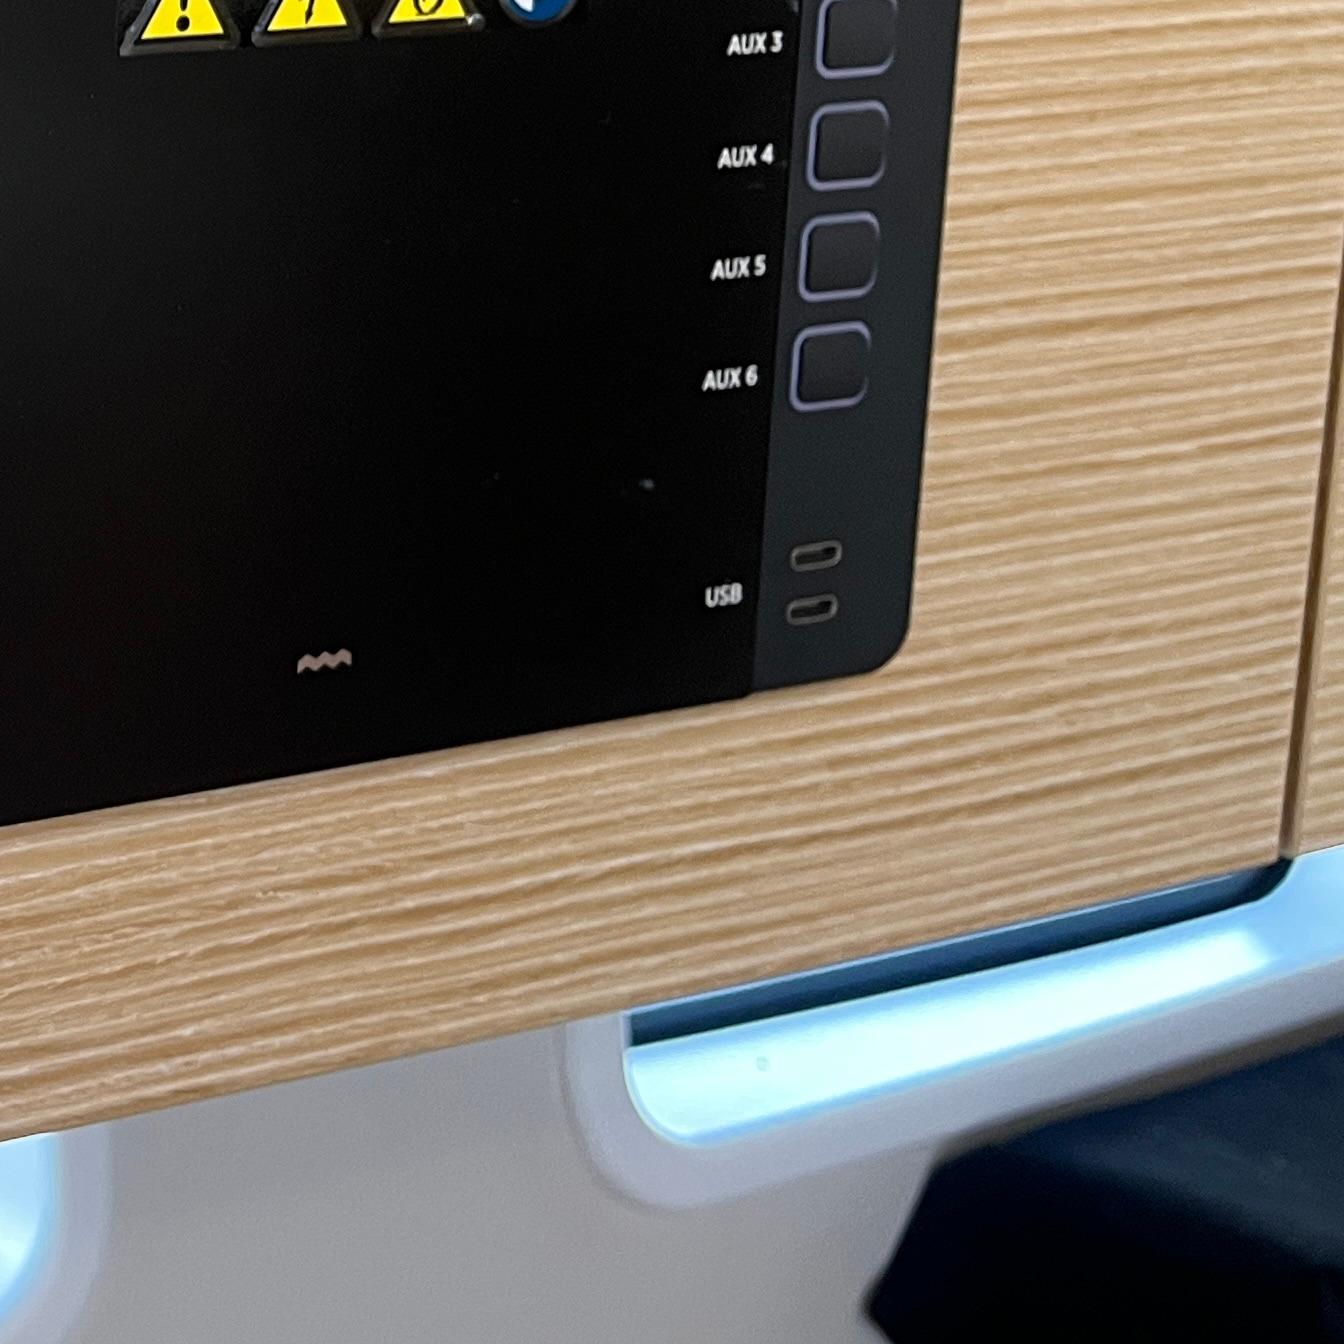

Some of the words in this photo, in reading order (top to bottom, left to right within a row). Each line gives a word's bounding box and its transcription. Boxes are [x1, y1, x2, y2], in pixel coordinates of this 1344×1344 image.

[727, 32, 767, 56] AUX
[770, 30, 783, 53] 3
[717, 144, 758, 169] AUX
[760, 143, 774, 164] 4
[711, 256, 751, 281] AUX
[754, 254, 767, 277] 5
[702, 366, 742, 391] AUX
[745, 364, 758, 387] 6
[705, 582, 743, 608] USB
